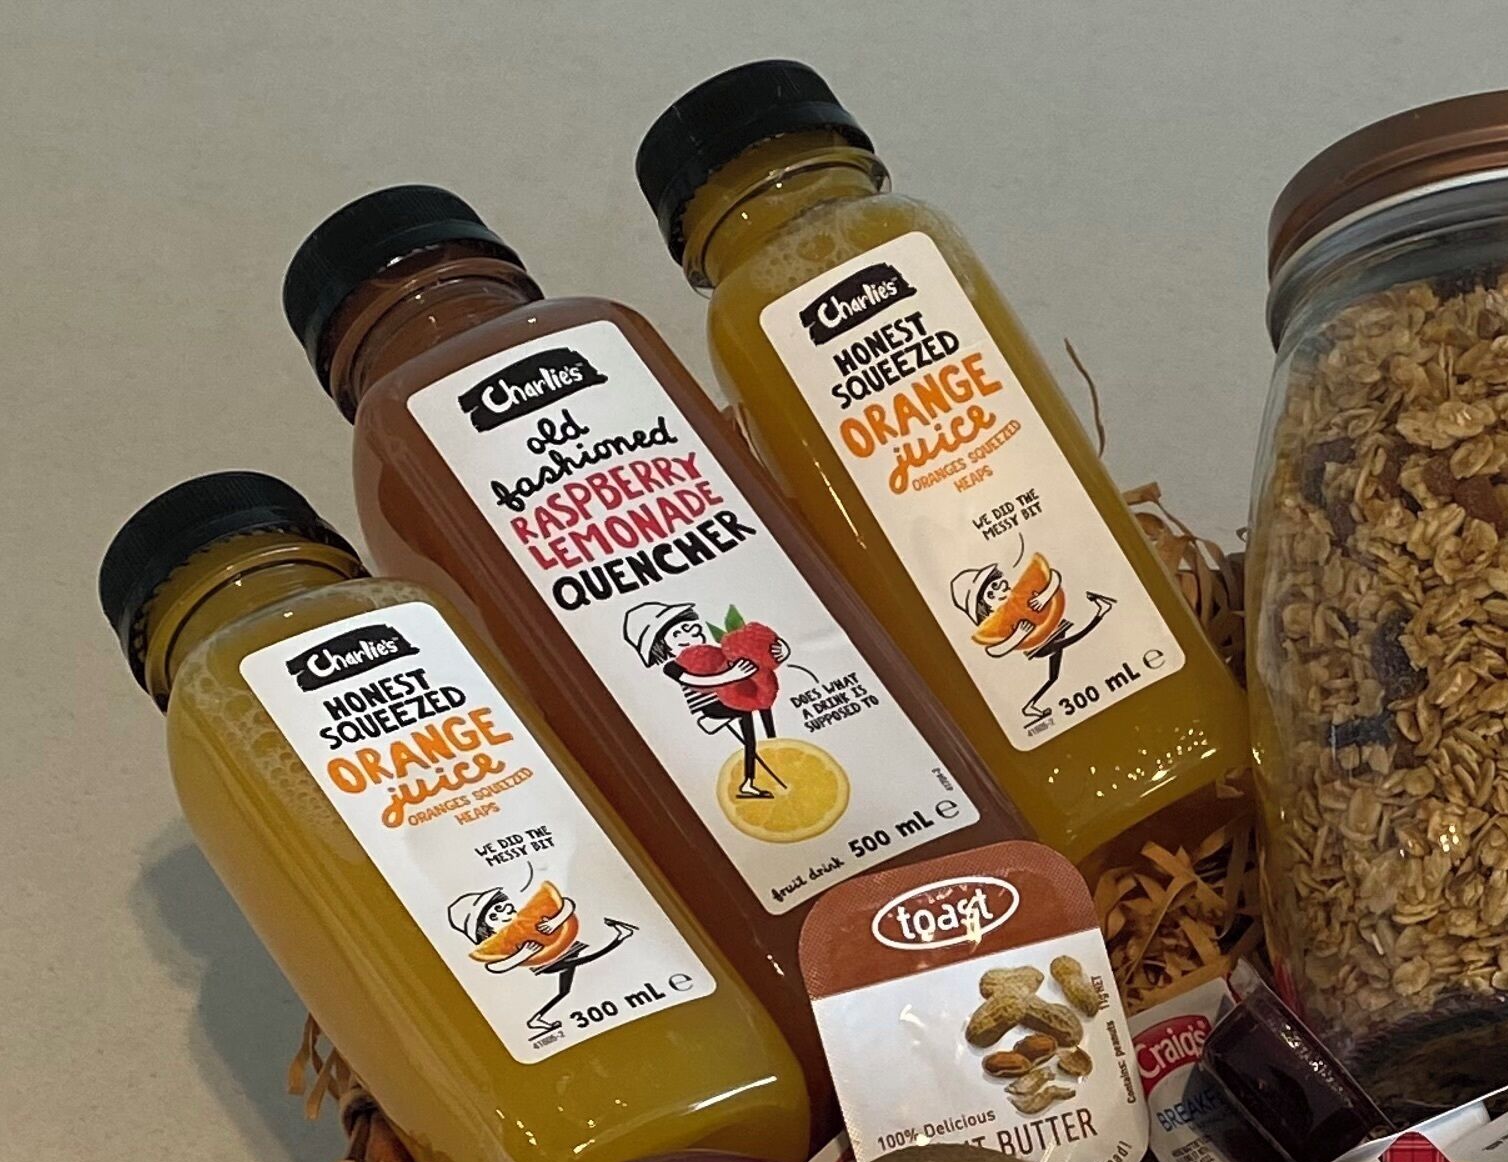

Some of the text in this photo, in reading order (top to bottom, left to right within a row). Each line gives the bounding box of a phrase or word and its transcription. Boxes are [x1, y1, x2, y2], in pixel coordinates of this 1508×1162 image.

[817, 279, 898, 328] Charlie's
[832, 330, 959, 409] SQUEEZED
[833, 311, 927, 376] HONEST
[482, 366, 582, 413] Charlie's
[840, 352, 1003, 458] ORANGE
[527, 409, 589, 454] old
[889, 405, 996, 495] juice
[912, 420, 1022, 491] ORANGES SQUEEZED
[491, 416, 678, 512] fashioned
[953, 465, 993, 493] HEAPS
[511, 452, 702, 544] RASPBERRY
[972, 489, 1039, 530] WE DID THE
[982, 503, 1043, 541] MESSY BIT
[529, 481, 724, 570] LEMONADE
[552, 511, 756, 610] QUENCHER
[307, 639, 398, 676] Charlie's
[323, 668, 430, 721] HONEST
[790, 672, 859, 709] DOES WHAT
[803, 685, 867, 720] A DRINK IS
[804, 695, 880, 732] SUPPOSED TO
[1059, 686, 1100, 716] 300
[1105, 662, 1141, 692] mL
[320, 686, 466, 750] SQUEEZED
[327, 708, 514, 793] ORANGE
[382, 753, 505, 828] juice
[408, 768, 533, 826] ORANGES SQUEEZED
[455, 802, 500, 825] HEAPS
[475, 826, 552, 856] WE DID THE
[486, 837, 554, 866] MESSY BIT
[772, 876, 806, 902] fruit
[810, 857, 844, 880] drink
[848, 830, 890, 857] 500
[895, 811, 934, 838] mL
[896, 888, 993, 942] toast
[569, 1000, 618, 1029] 300
[623, 981, 666, 1009] mL
[1106, 1020, 1125, 1057] peanuts
[1135, 1020, 1207, 1079] Craig's
[924, 1110, 996, 1138] Delicious
[997, 1108, 1098, 1156] BUTTER
